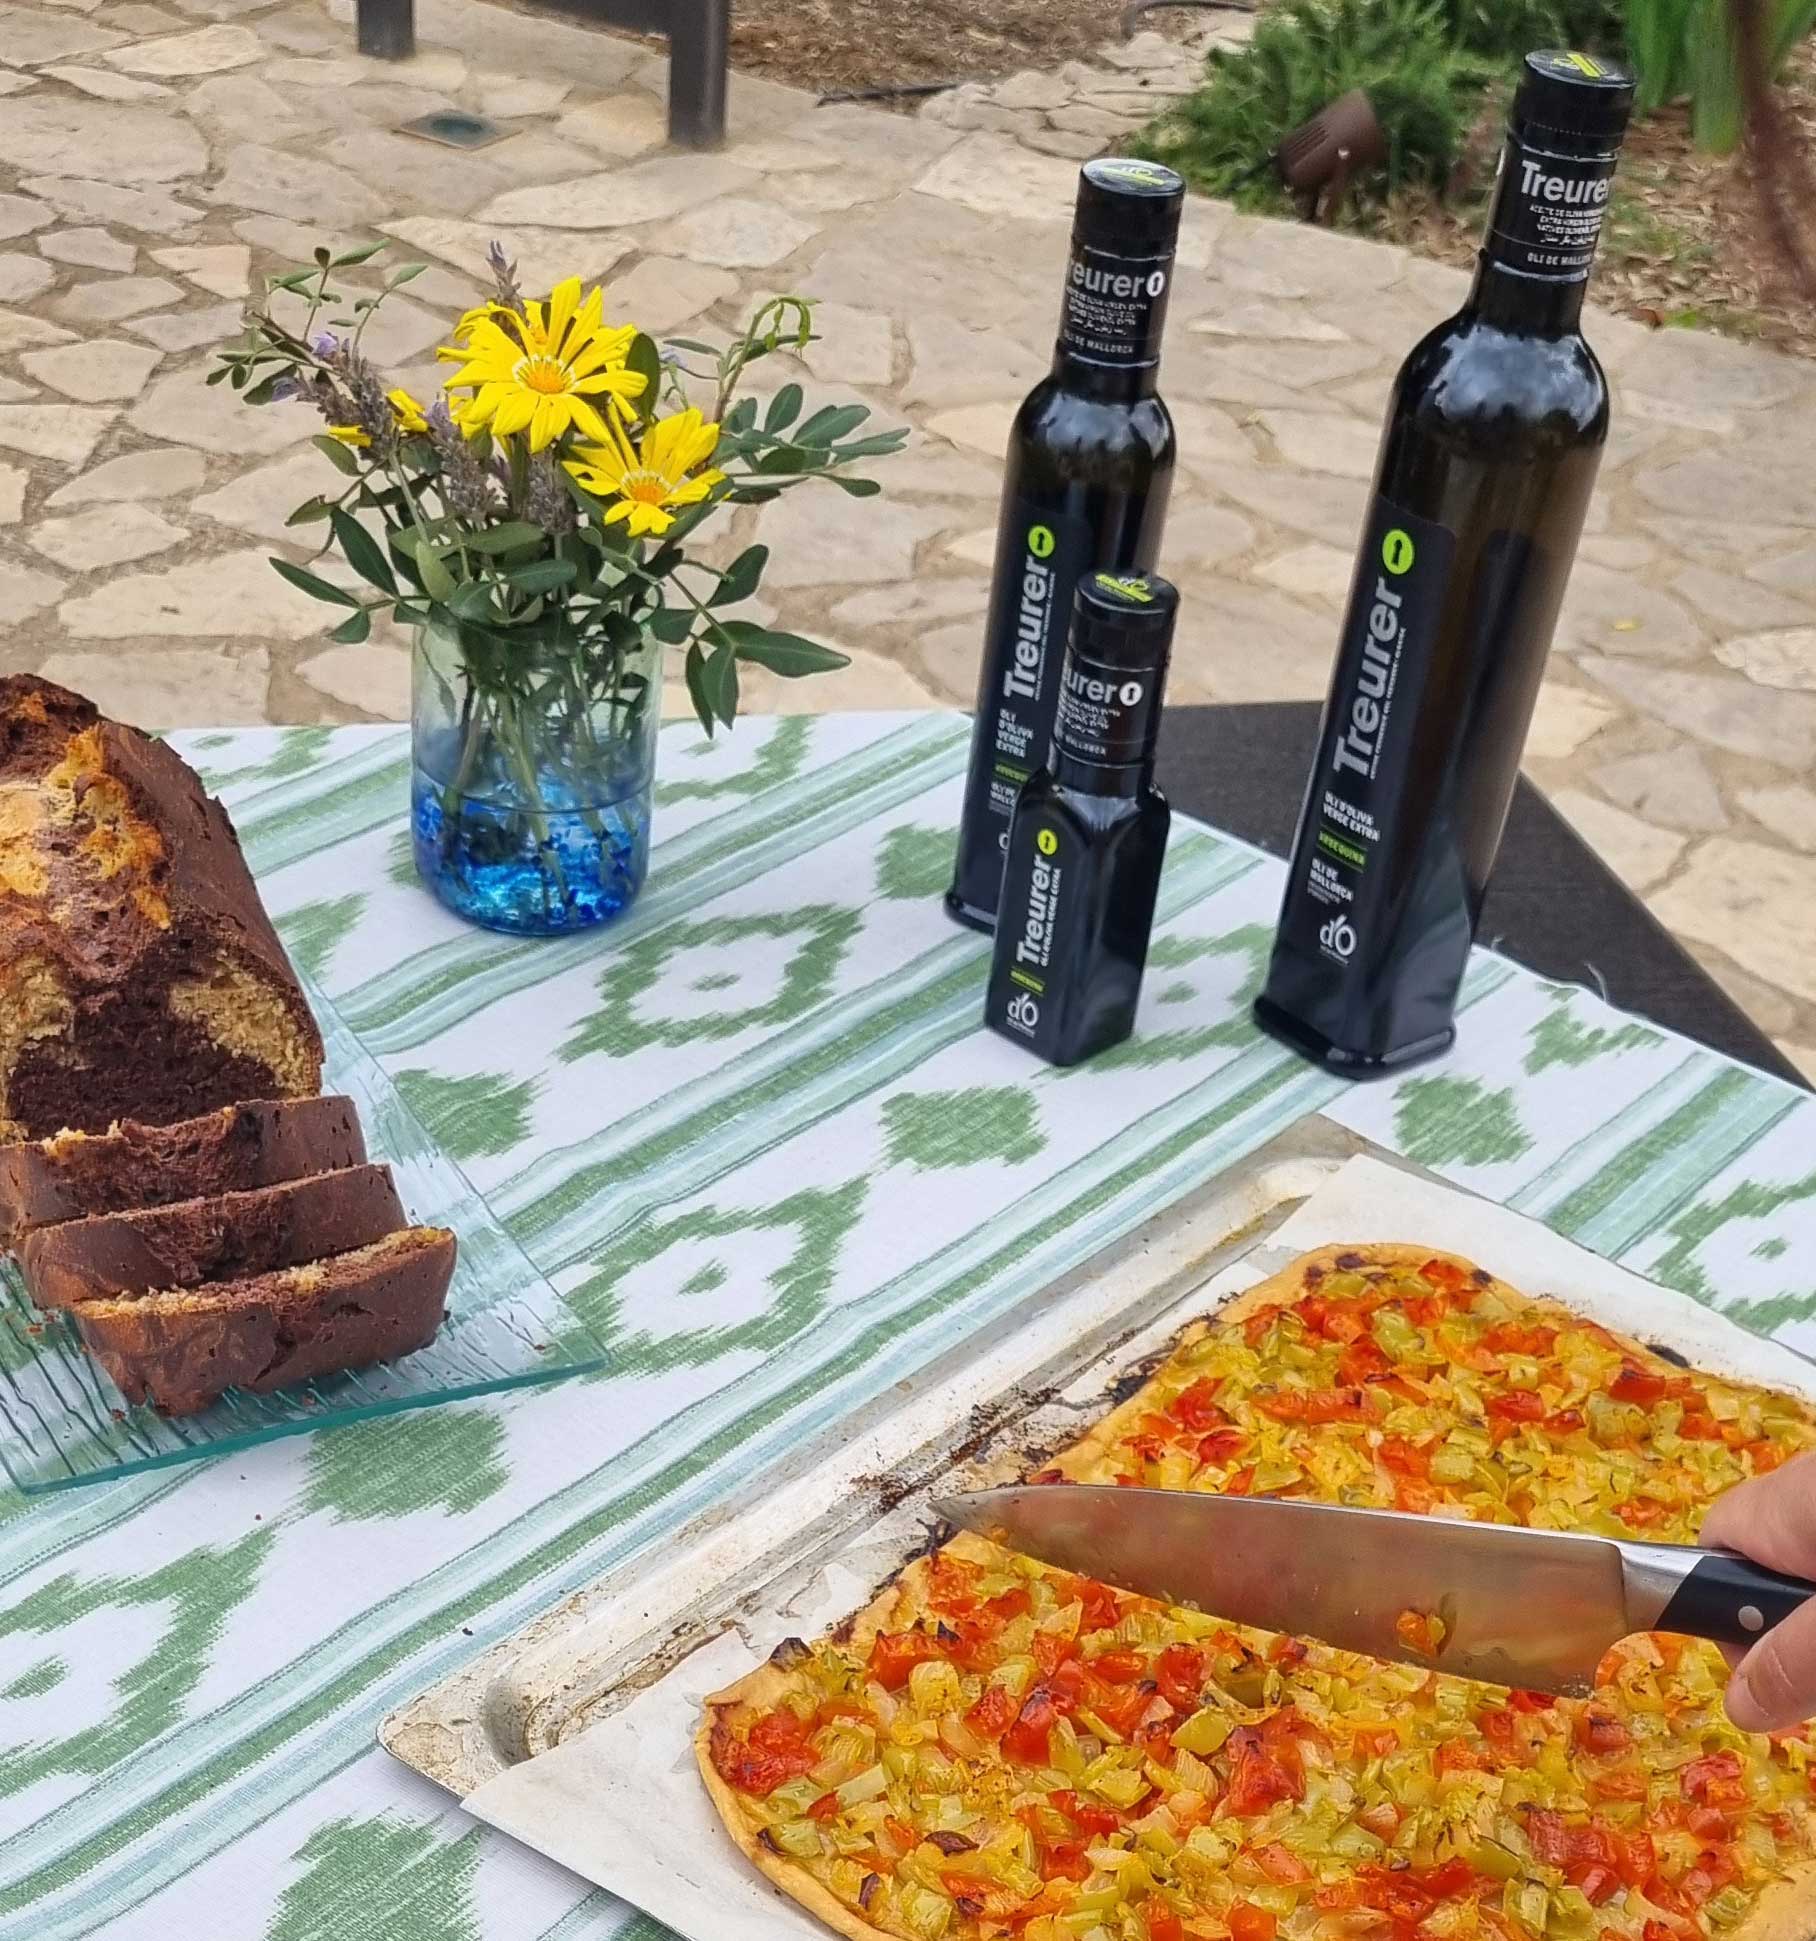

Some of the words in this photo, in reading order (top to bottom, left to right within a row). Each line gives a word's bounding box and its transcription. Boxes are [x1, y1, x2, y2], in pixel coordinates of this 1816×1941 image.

[1521, 159, 1609, 204] Treure
[1071, 260, 1145, 299] eurer
[1333, 575, 1403, 777] Treurer
